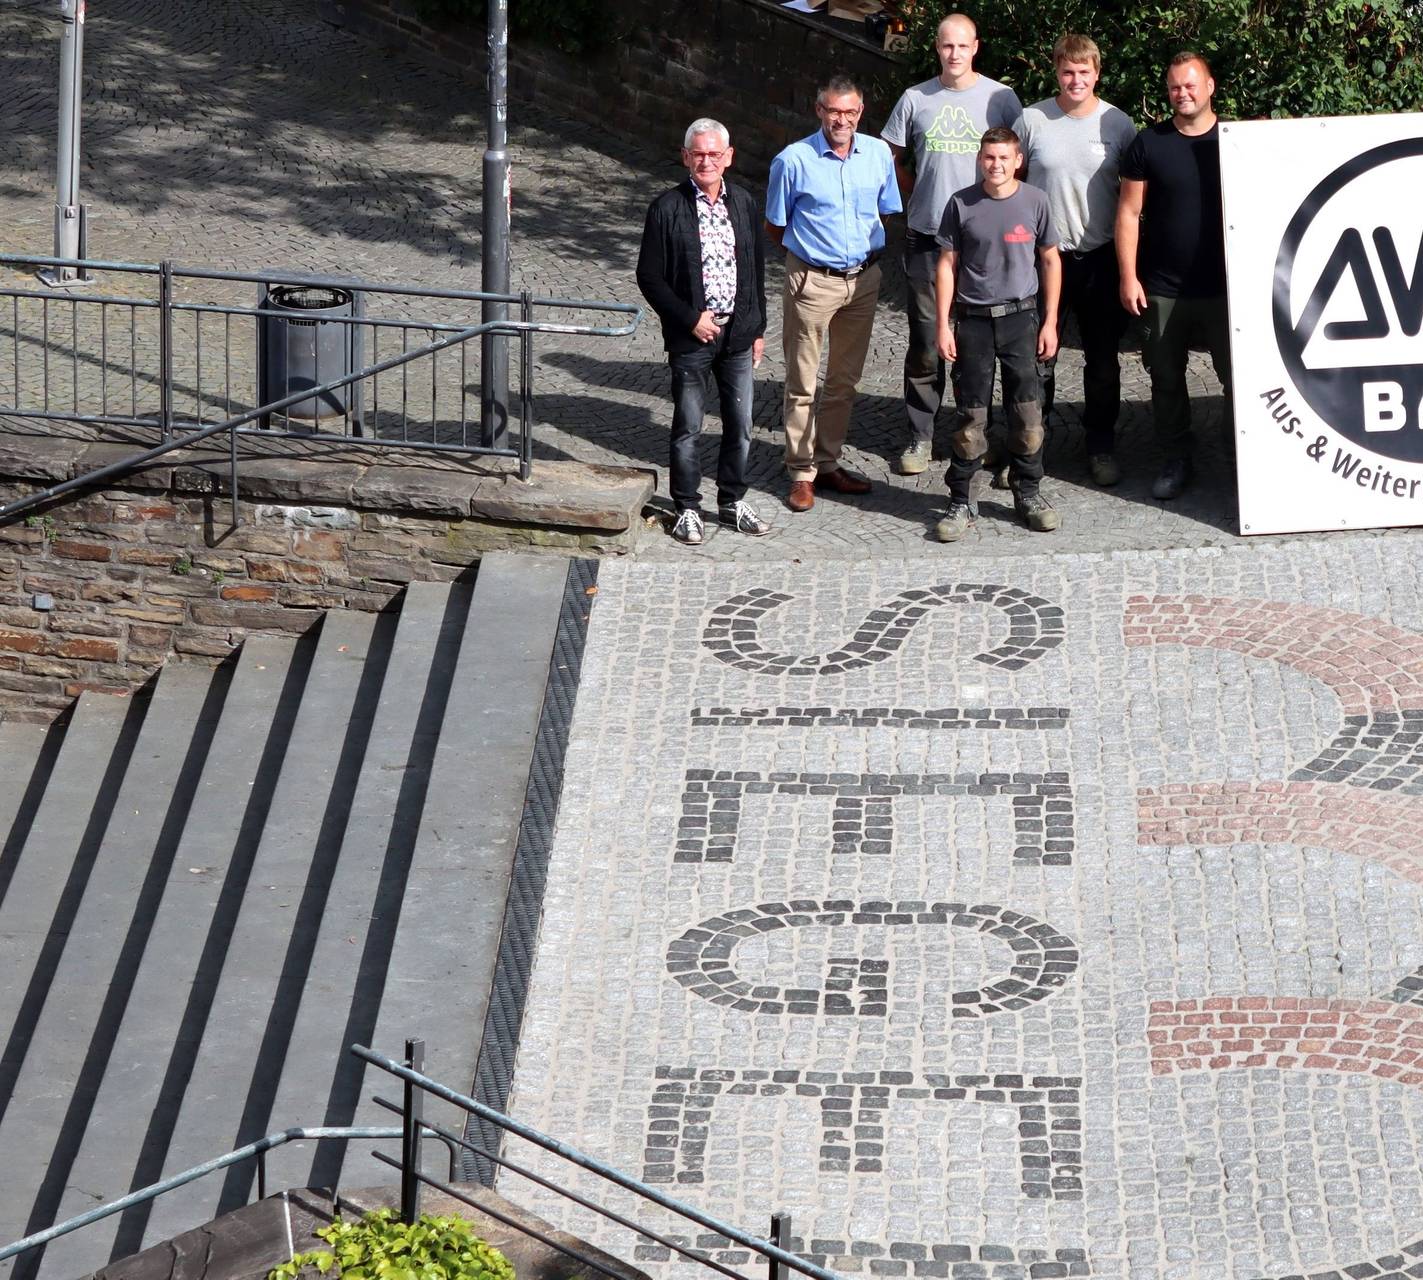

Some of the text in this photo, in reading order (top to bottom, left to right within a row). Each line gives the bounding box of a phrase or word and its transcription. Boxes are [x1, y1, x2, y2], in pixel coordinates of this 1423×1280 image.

[925, 138, 981, 154] Kappa
[1259, 386, 1305, 440] Aus-
[1305, 434, 1329, 464] &
[634, 583, 1090, 1280] SIEGE
